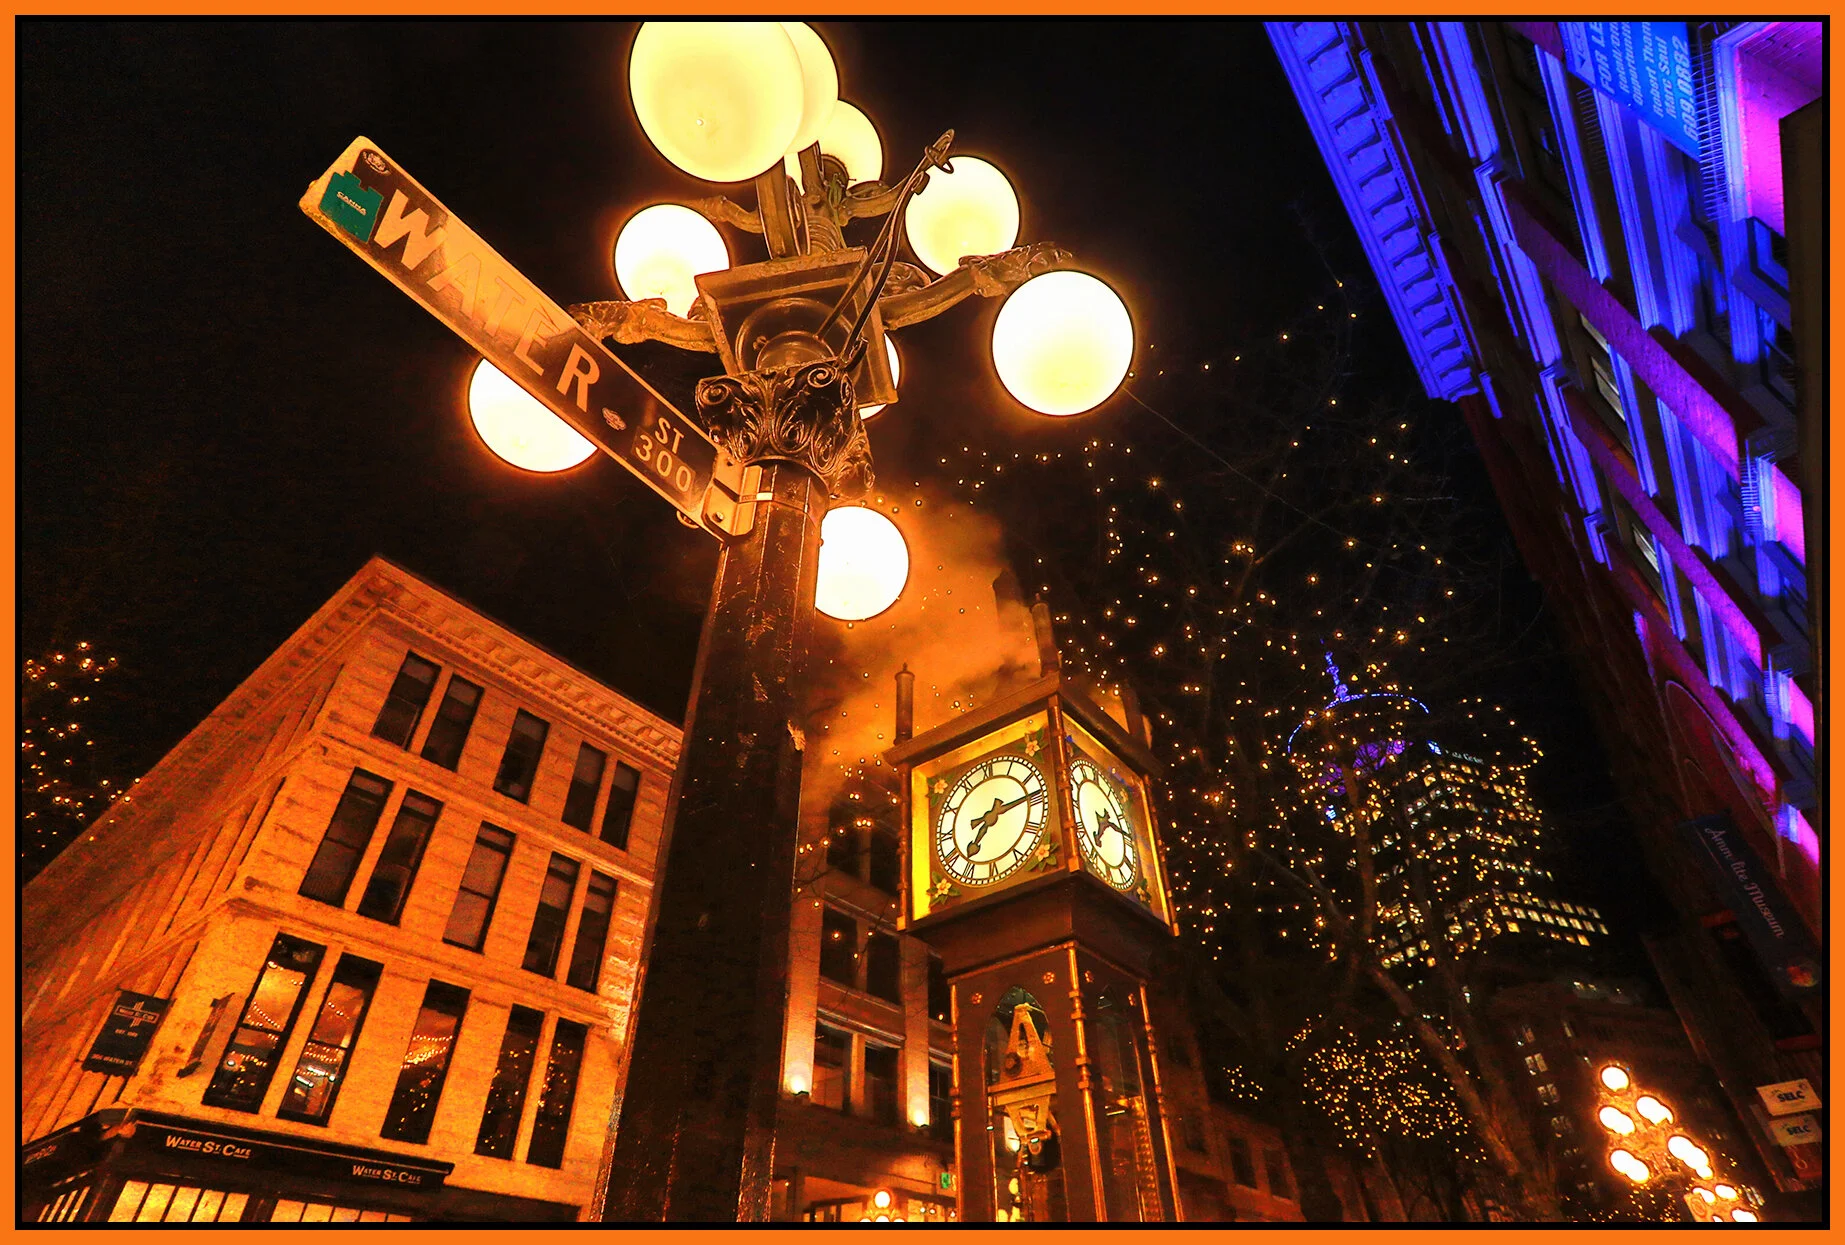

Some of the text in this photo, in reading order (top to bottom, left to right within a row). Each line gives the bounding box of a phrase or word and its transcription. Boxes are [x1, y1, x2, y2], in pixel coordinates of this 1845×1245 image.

[1595, 49, 1614, 94] FOR
[1662, 78, 1677, 119] Marc
[374, 189, 600, 412] WATER
[653, 417, 686, 453] ST
[635, 432, 693, 493] 300
[1744, 882, 1785, 939] Museum
[165, 1135, 202, 1151] WATER
[222, 1144, 251, 1159] CAFE
[352, 1165, 382, 1178] WATER
